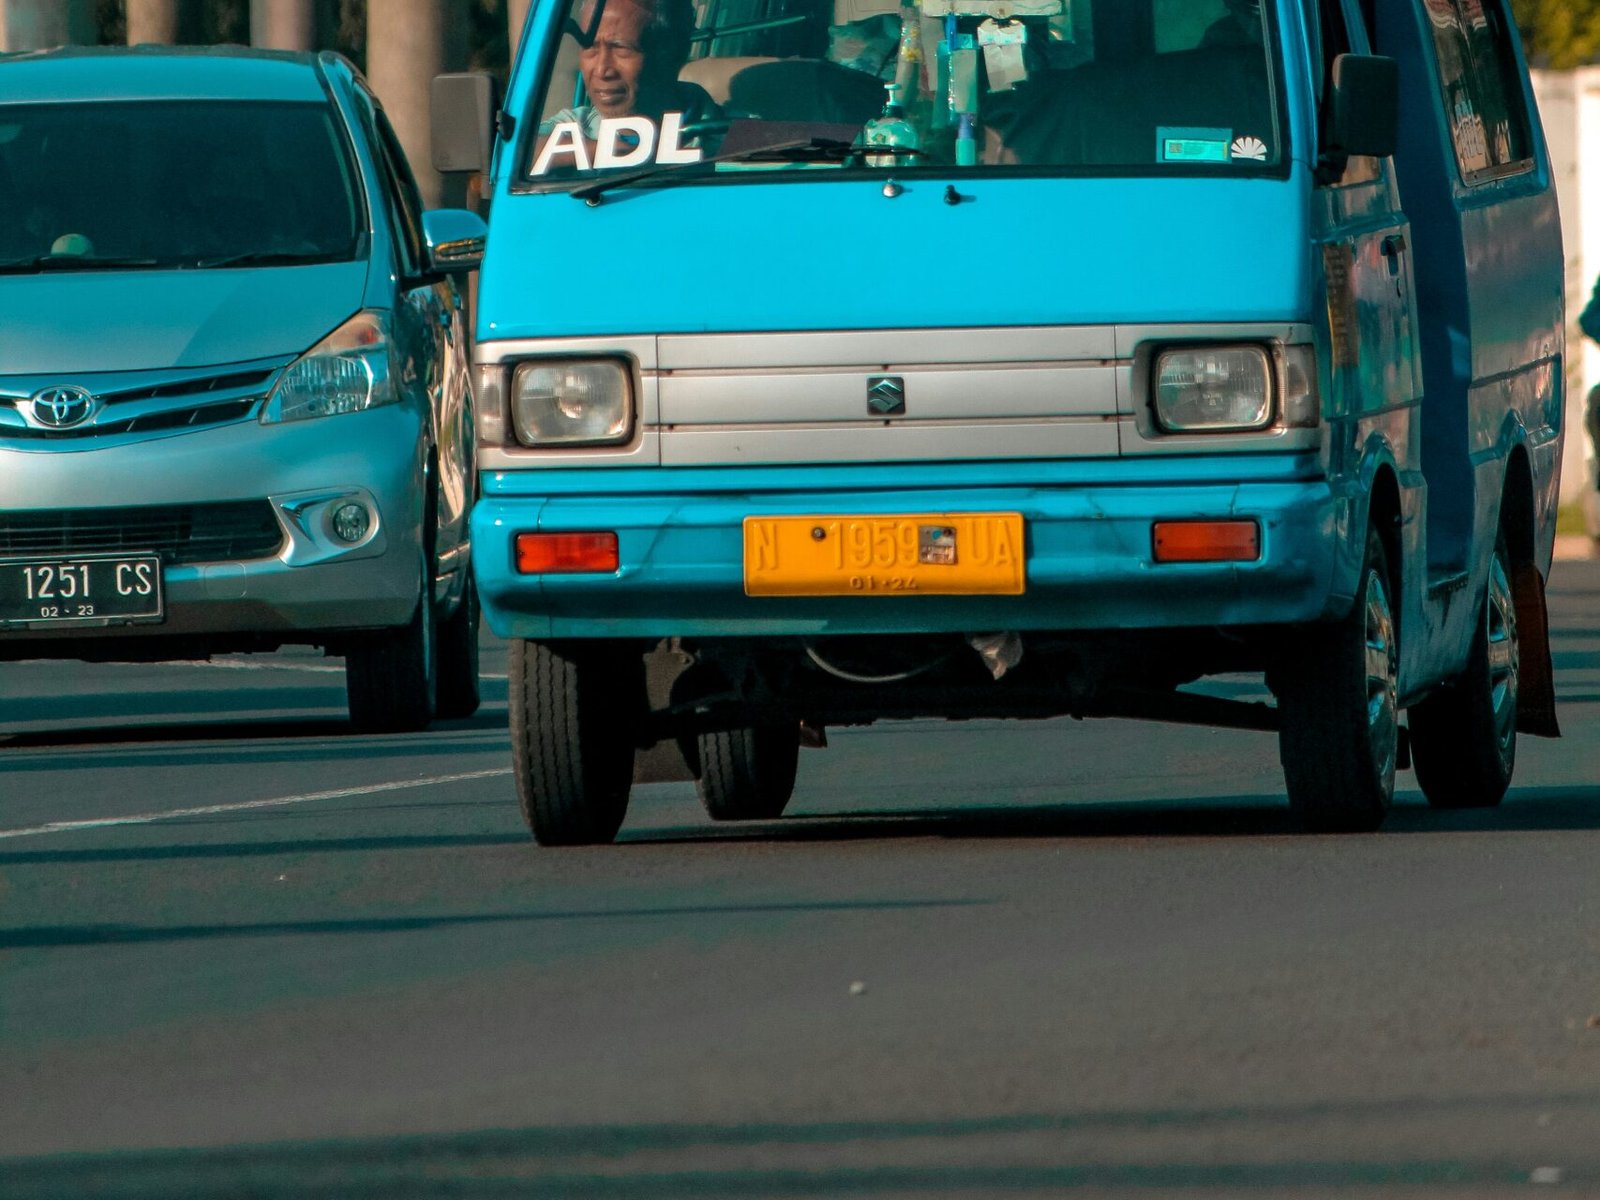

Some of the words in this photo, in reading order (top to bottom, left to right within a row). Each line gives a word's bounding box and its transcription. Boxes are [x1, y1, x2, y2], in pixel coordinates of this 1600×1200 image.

[529, 112, 702, 176] ADL
[752, 522, 779, 571] N
[829, 520, 921, 570] 1959
[965, 519, 1016, 568] UA
[23, 564, 90, 600] 1251
[116, 563, 152, 596] CS
